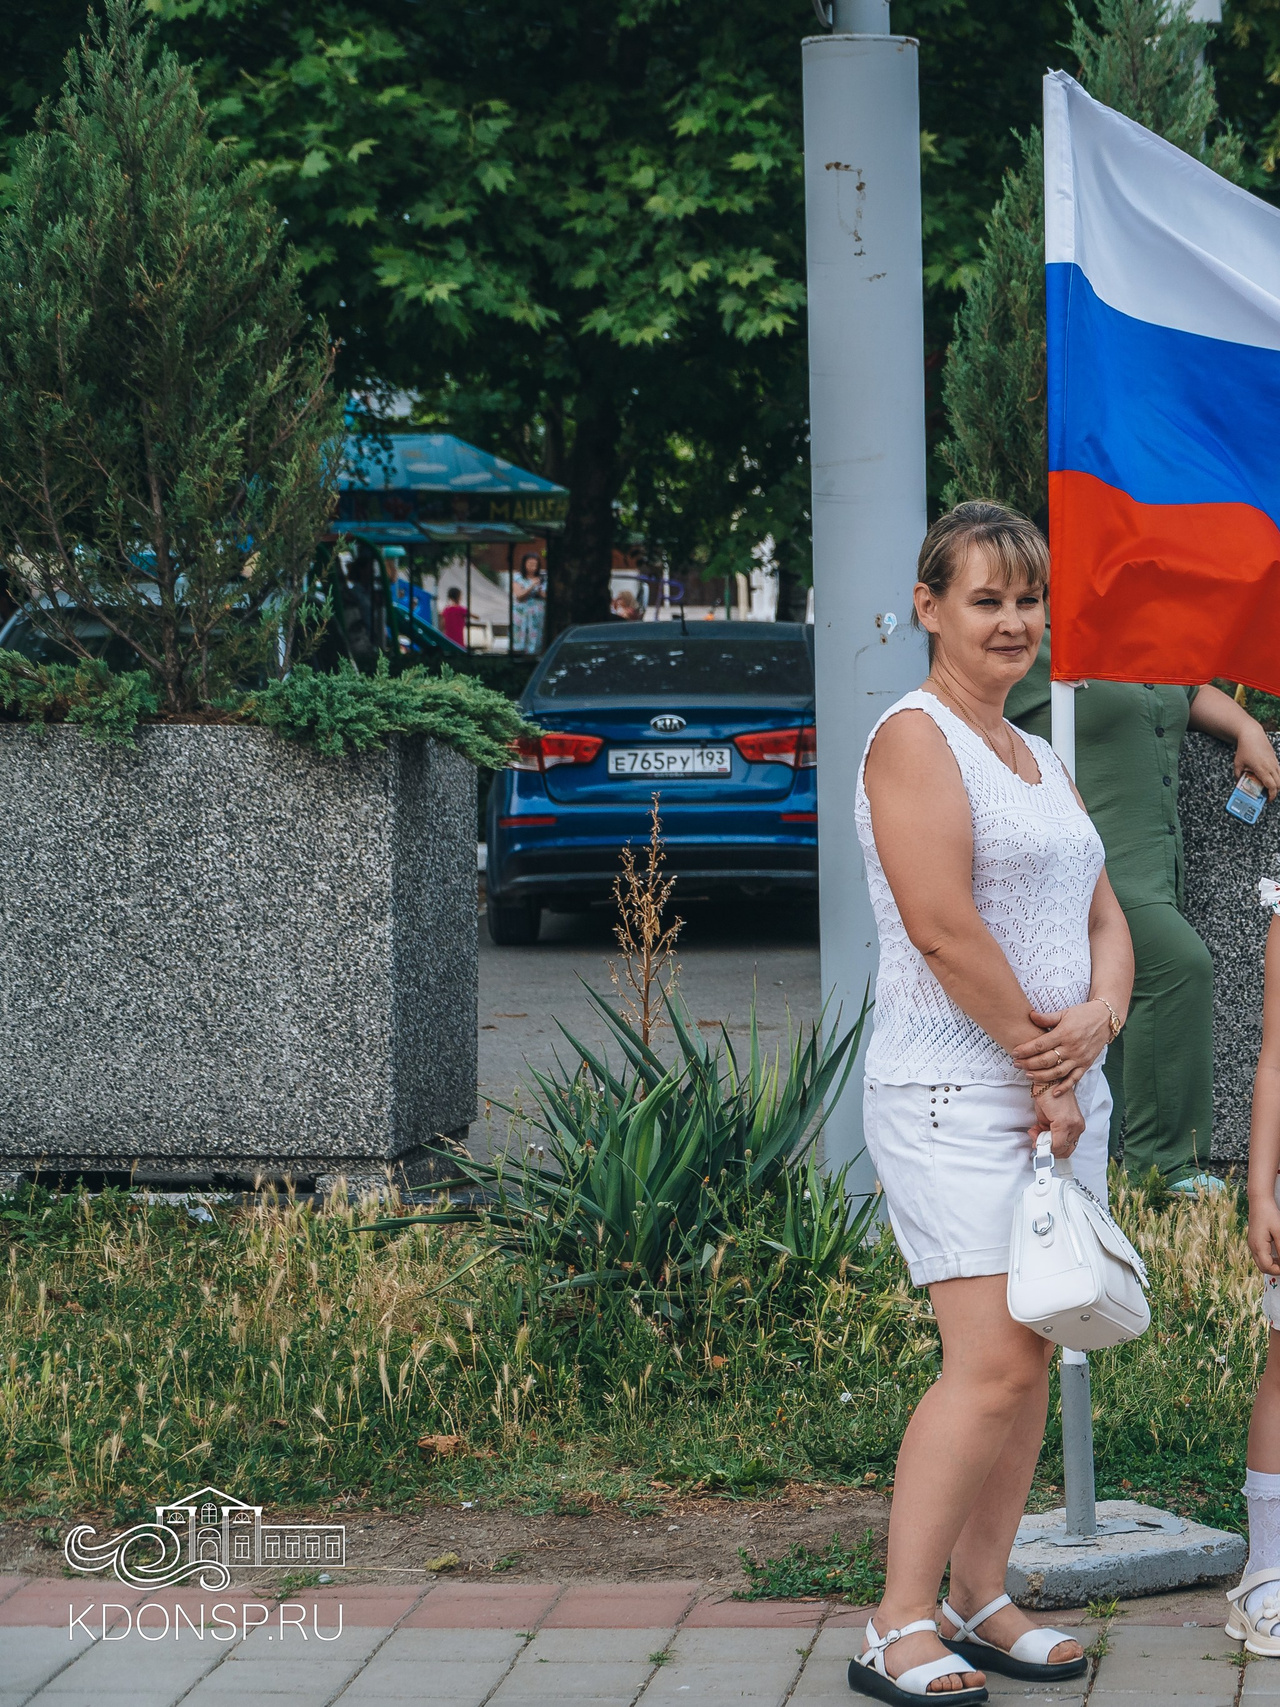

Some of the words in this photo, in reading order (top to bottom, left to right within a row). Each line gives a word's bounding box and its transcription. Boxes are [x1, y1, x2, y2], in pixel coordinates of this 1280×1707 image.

[656, 718, 681, 731] KIA
[615, 752, 691, 772] Е765РУ
[696, 751, 726, 766] 193
